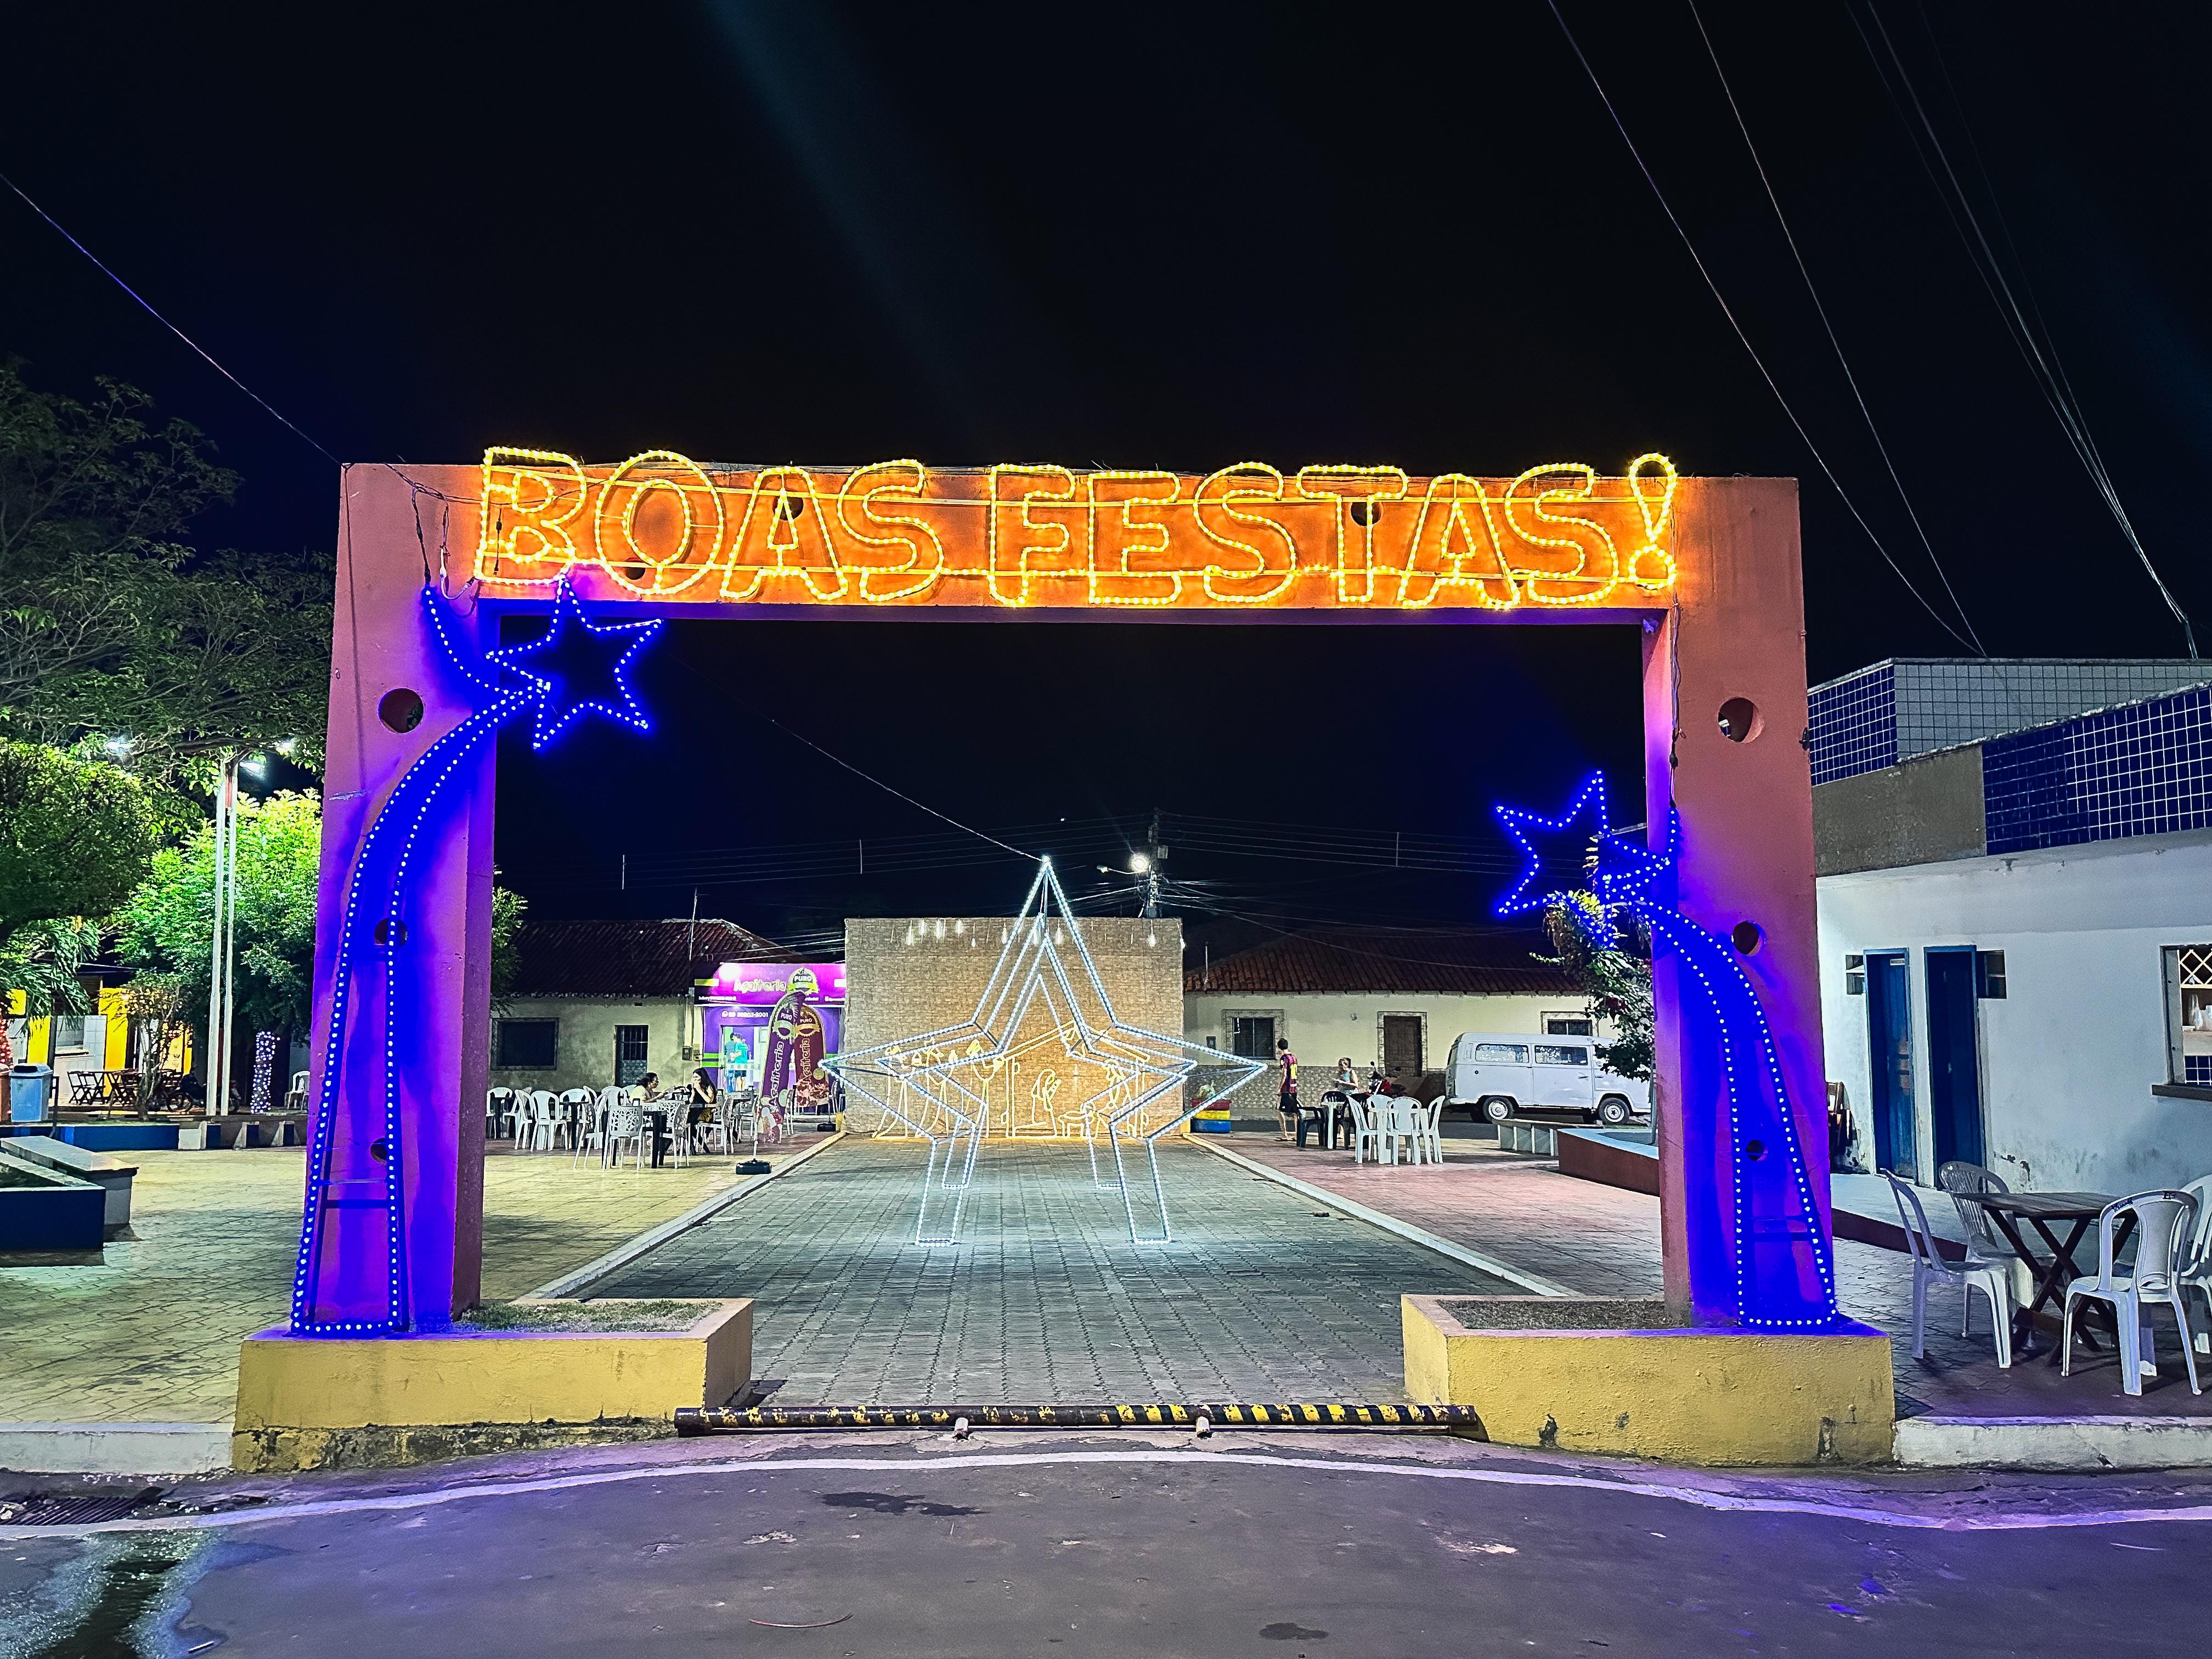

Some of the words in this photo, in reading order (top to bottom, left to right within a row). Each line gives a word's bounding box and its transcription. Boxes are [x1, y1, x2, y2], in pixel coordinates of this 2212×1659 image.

[472, 445, 945, 601] BOAS
[987, 453, 1678, 609] FESTAS!
[780, 1012, 793, 1020] PURO
